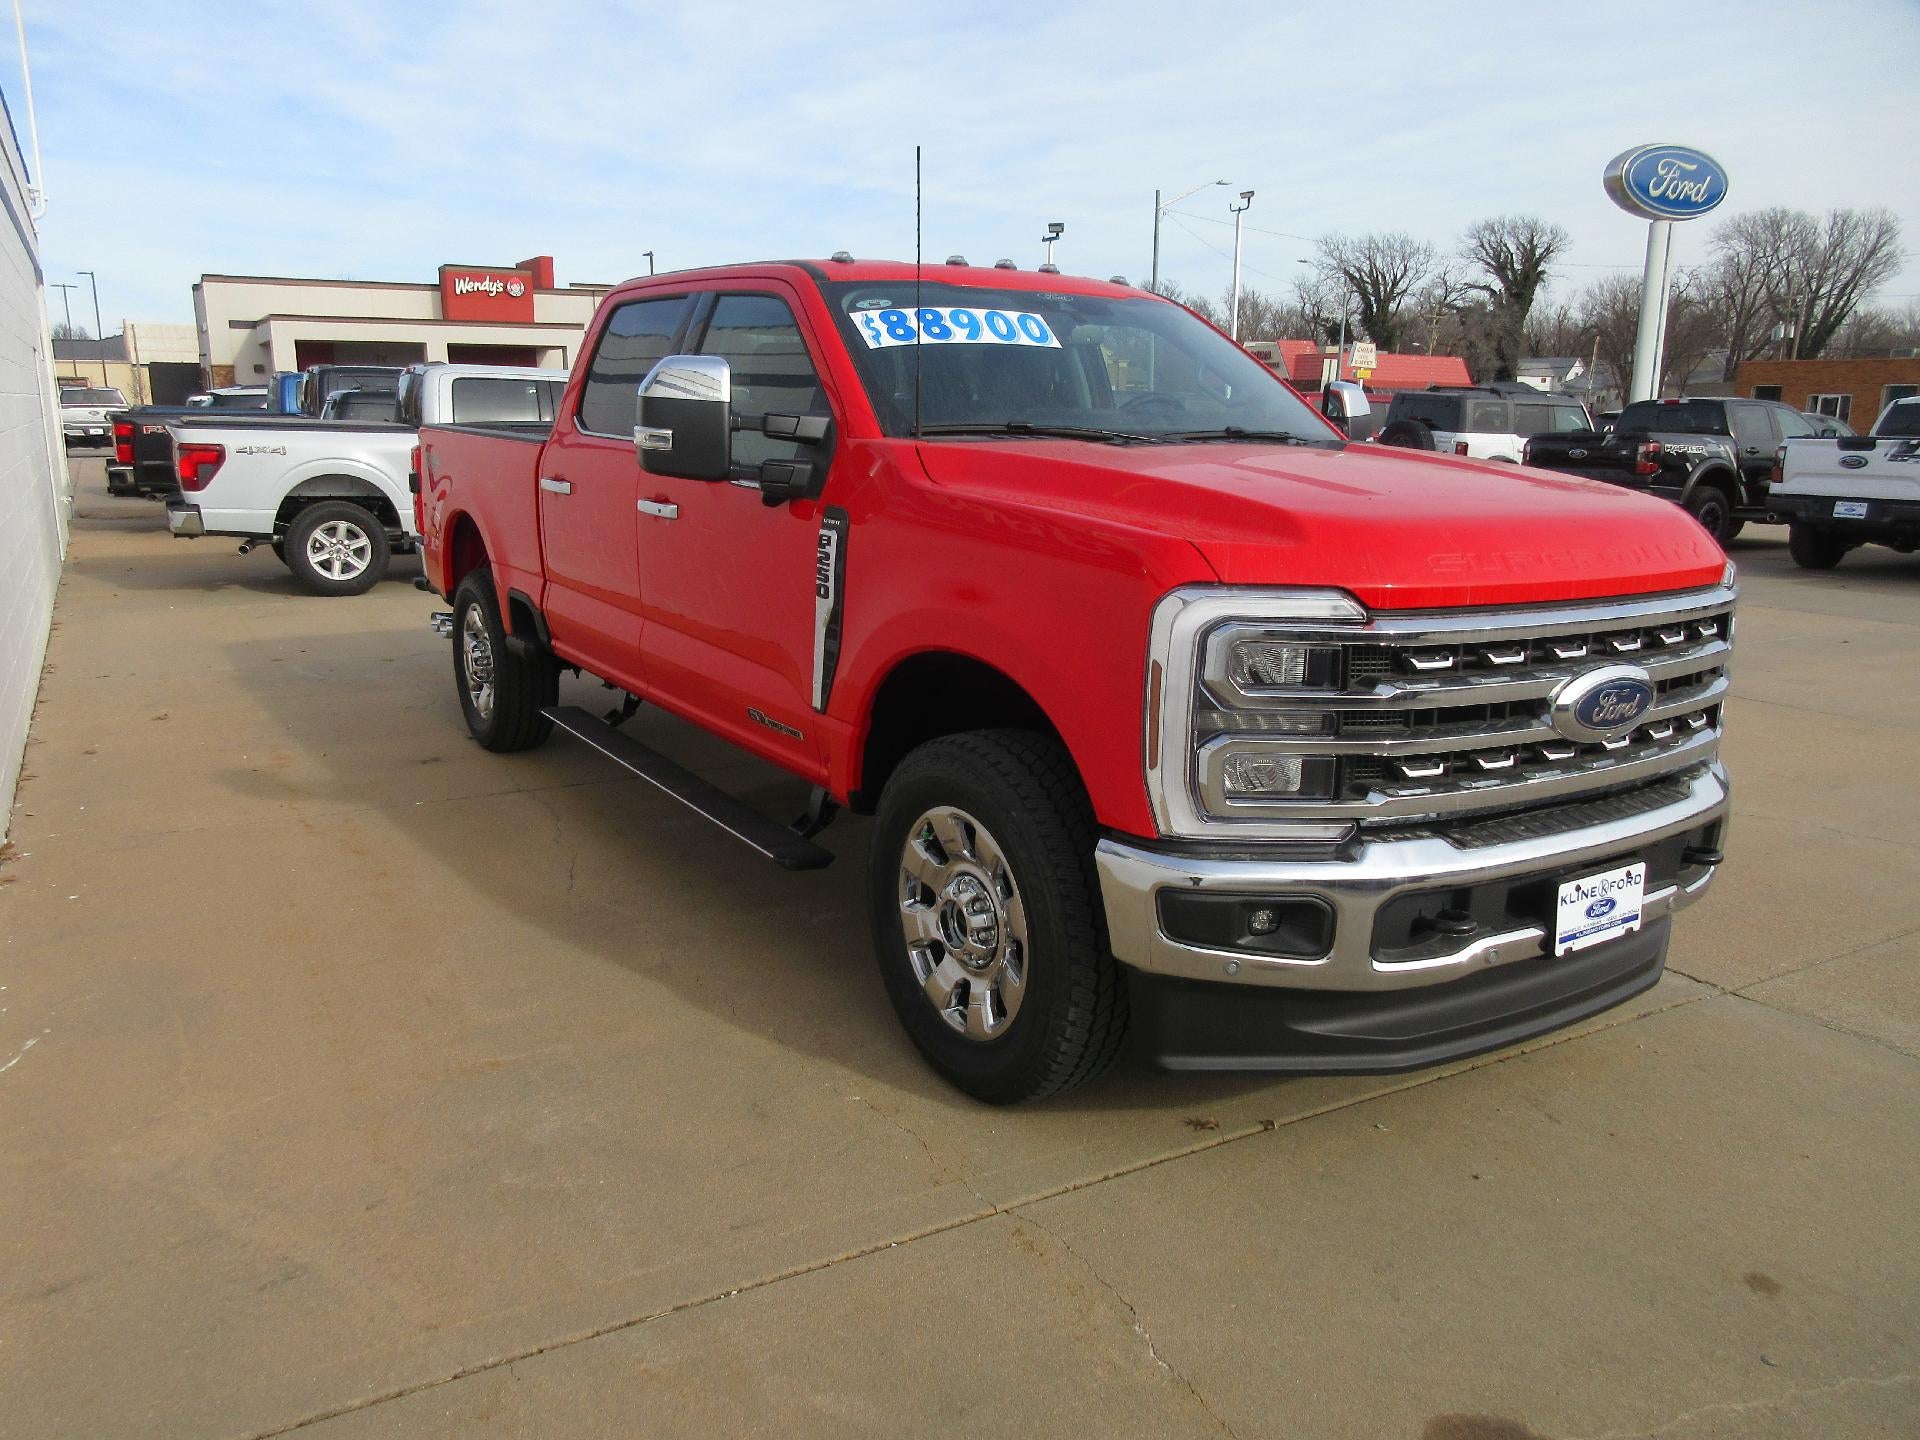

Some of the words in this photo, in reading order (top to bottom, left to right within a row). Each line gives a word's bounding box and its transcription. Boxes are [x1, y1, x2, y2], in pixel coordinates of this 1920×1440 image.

[1648, 158, 1712, 203] Ford
[455, 275, 504, 297] Wendy's
[860, 308, 1054, 347] $88900
[1664, 444, 1707, 456] RAPTOR
[1592, 688, 1640, 722] Ford
[1560, 887, 1597, 906] KLINE
[1610, 874, 1641, 892] FORD
[1590, 900, 1611, 917] Ford
